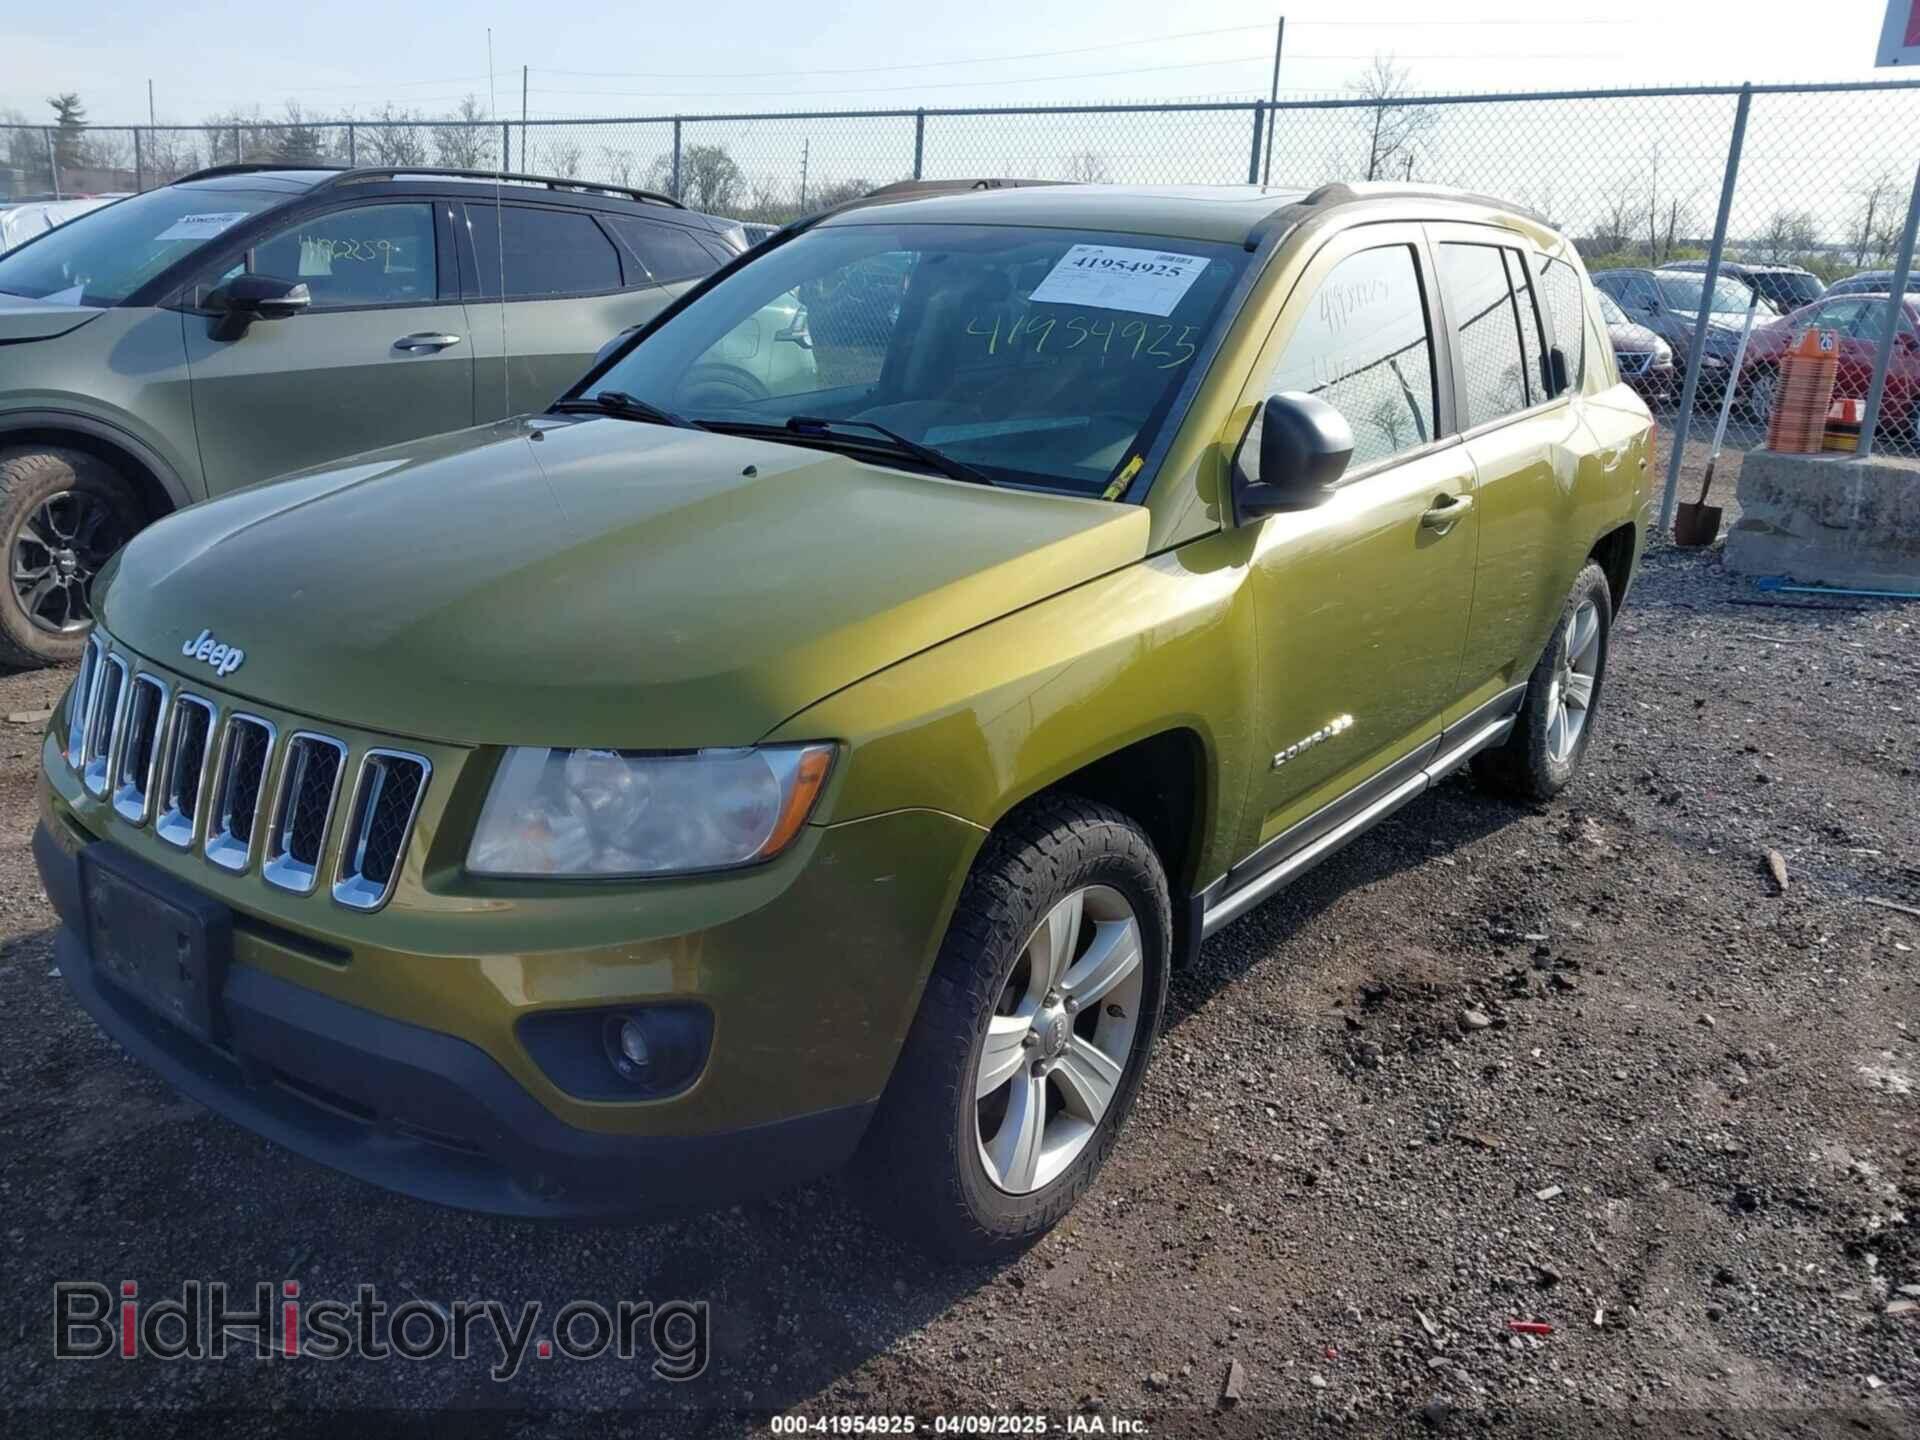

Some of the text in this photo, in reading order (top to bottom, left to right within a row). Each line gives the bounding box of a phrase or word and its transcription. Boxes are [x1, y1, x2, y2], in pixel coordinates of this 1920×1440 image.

[1072, 256, 1185, 278] 41954925
[966, 315, 1201, 369] 41954925
[182, 629, 245, 677] Jeep
